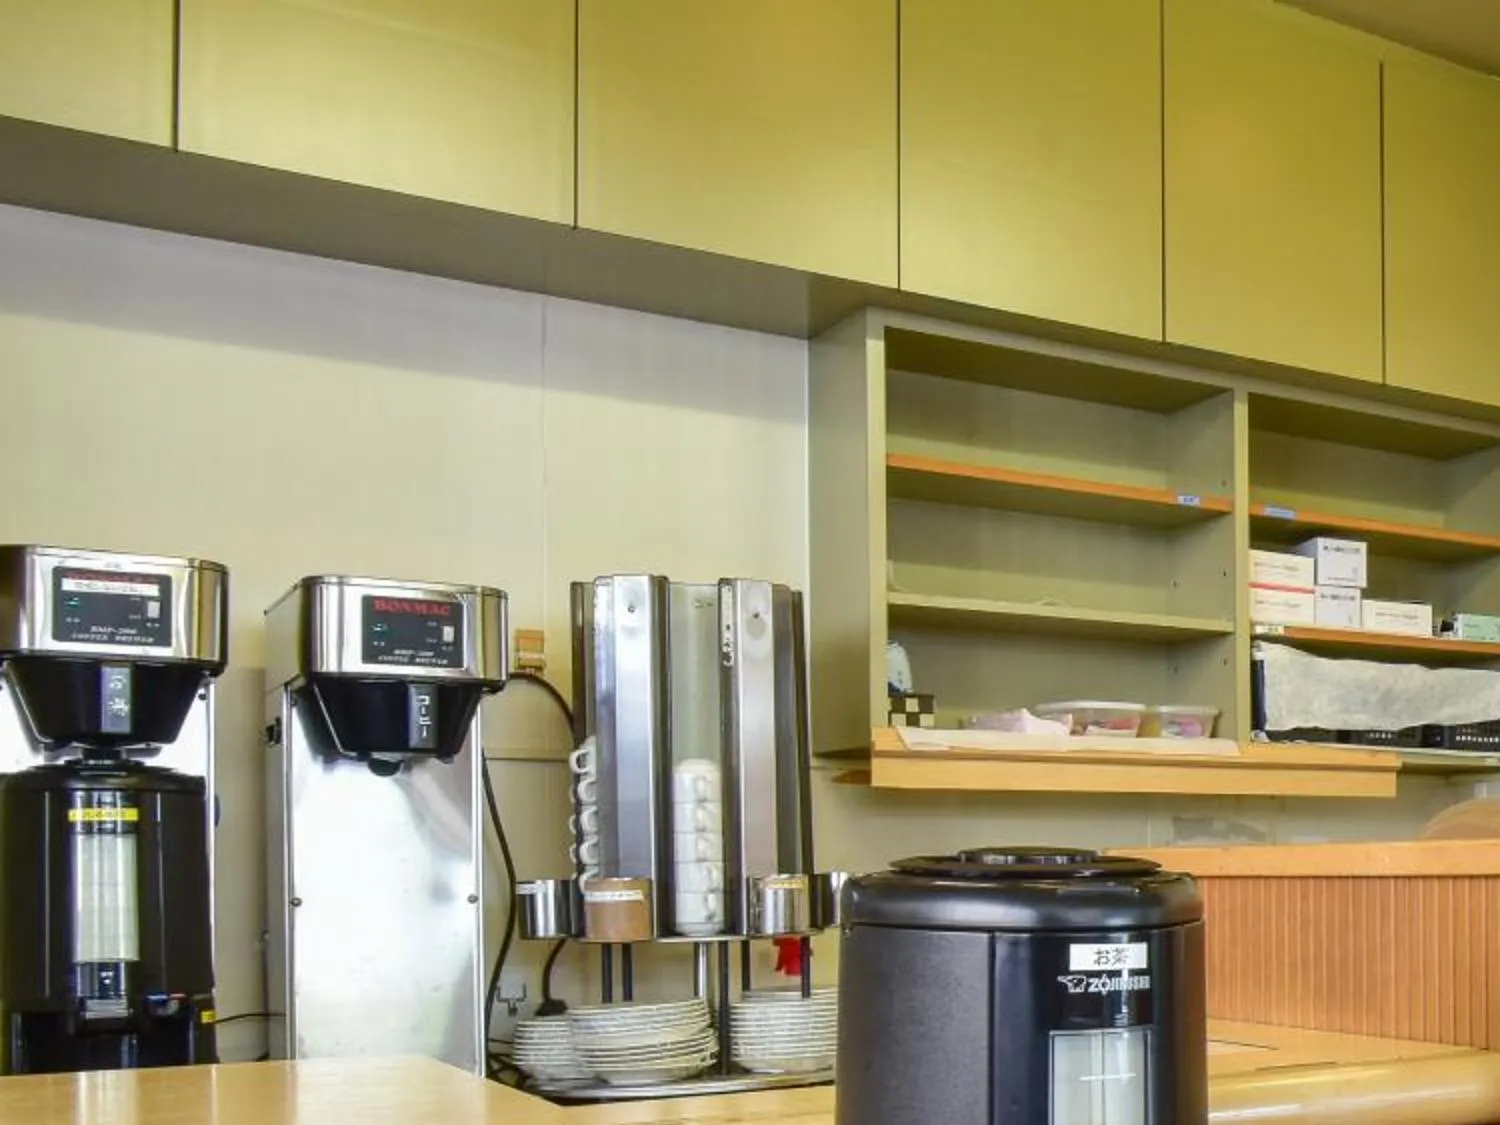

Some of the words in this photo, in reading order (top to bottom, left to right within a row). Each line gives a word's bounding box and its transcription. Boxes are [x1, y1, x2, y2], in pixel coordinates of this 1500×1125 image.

[375, 597, 451, 615] BONMAC
[417, 695, 432, 738] コーヒー
